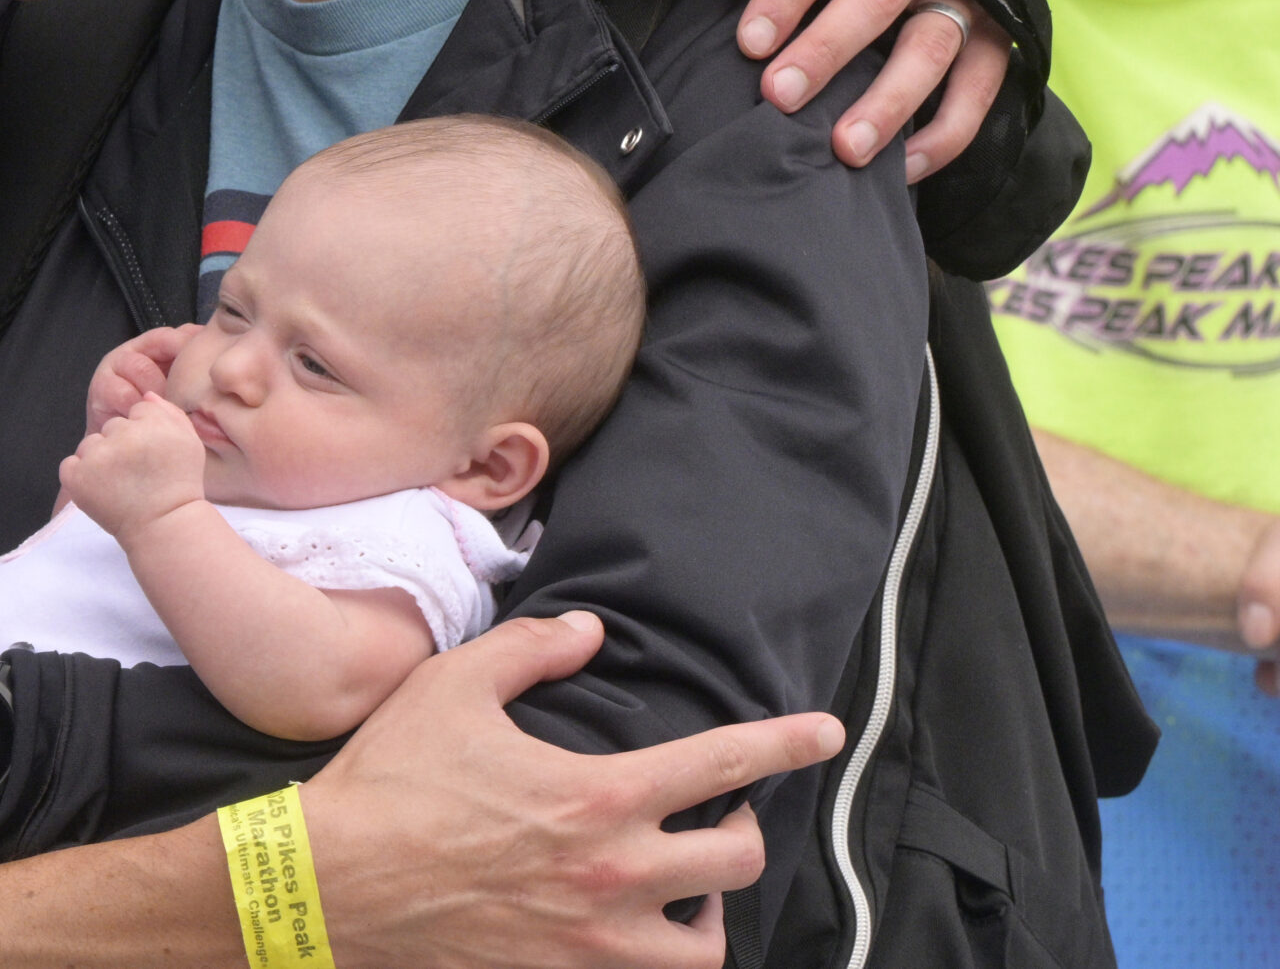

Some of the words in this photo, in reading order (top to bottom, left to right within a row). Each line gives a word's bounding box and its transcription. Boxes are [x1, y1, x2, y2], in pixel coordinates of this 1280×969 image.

[1066, 297, 1222, 341] PEAK
[1218, 301, 1280, 342] M
[235, 833, 255, 896] Ultimate
[247, 809, 282, 924] Marathon
[273, 823, 299, 894] Pikes
[289, 901, 316, 959] Peak
